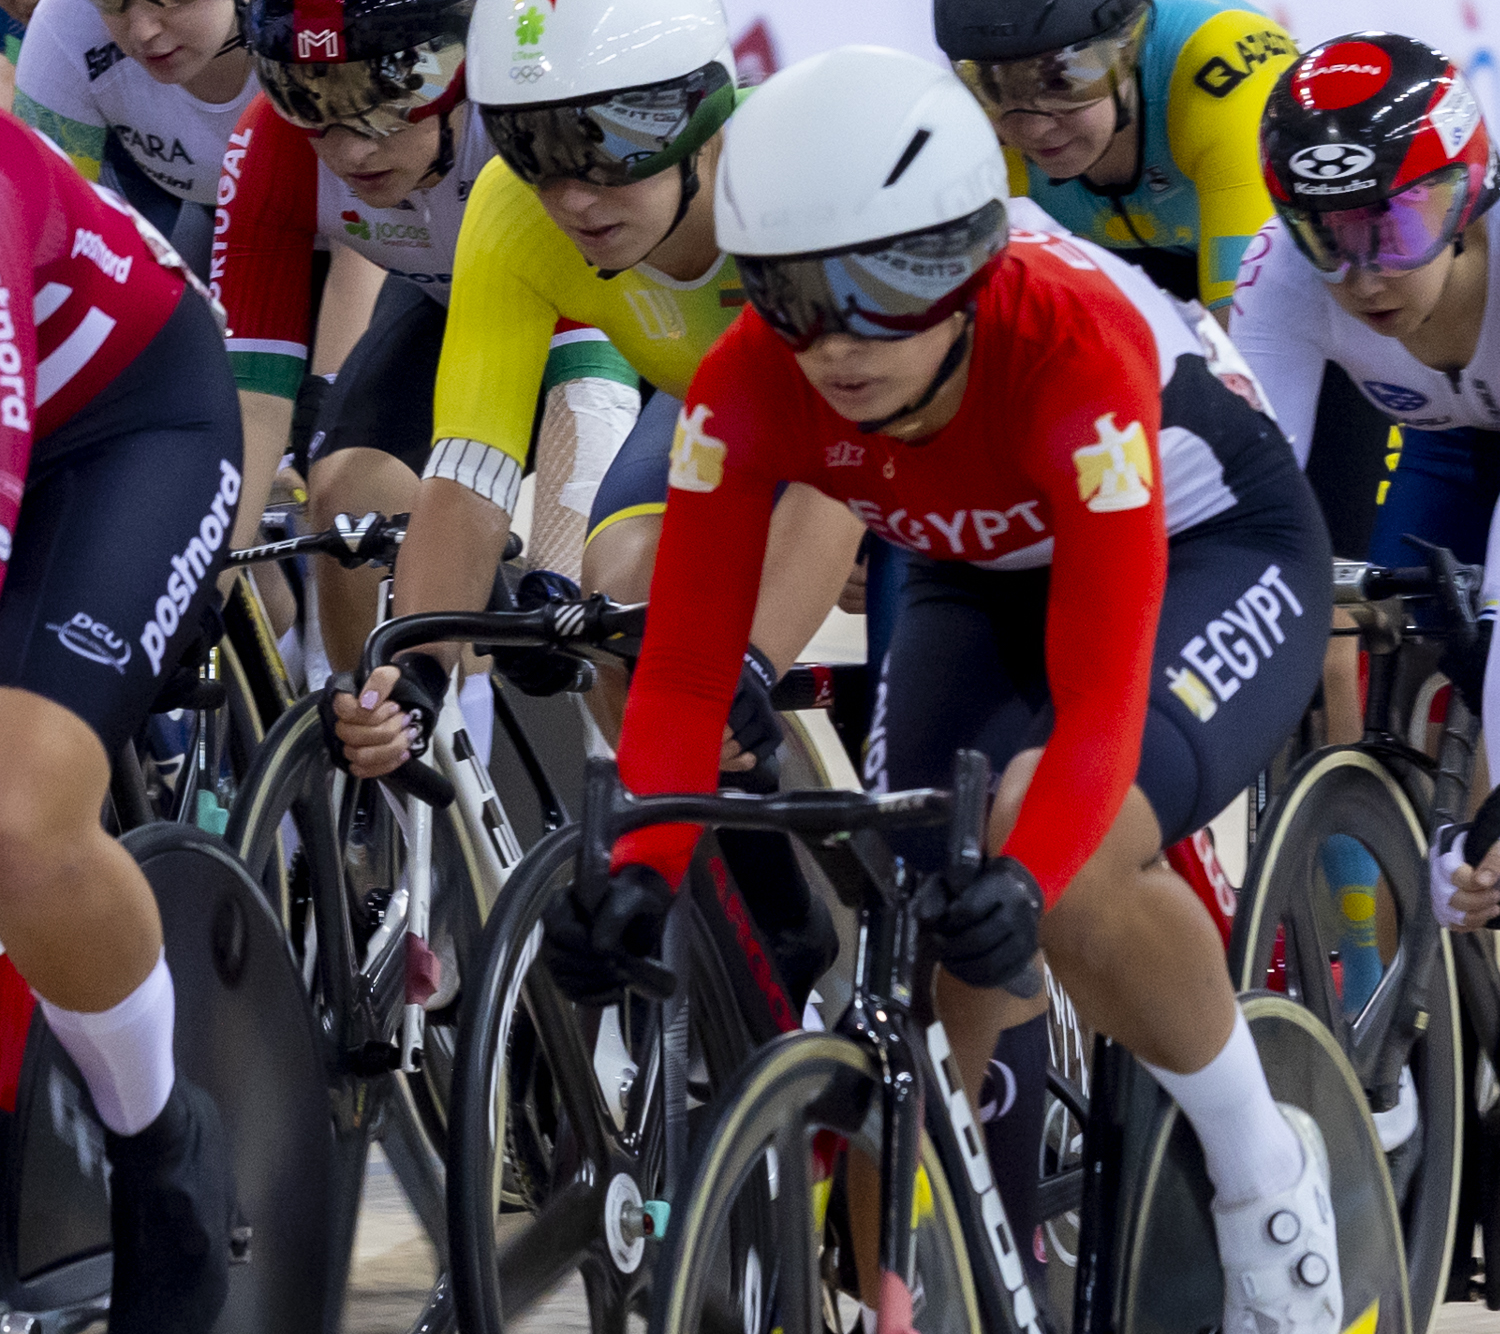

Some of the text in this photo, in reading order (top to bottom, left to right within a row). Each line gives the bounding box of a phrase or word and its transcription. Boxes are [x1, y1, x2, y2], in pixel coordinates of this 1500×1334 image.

[70, 227, 134, 284] postnord
[208, 127, 254, 301] ORTUGAL
[139, 458, 242, 677] postnord
[848, 498, 1046, 554] EGYPT
[71, 611, 124, 650] DCU
[1180, 564, 1304, 683] EGYPT
